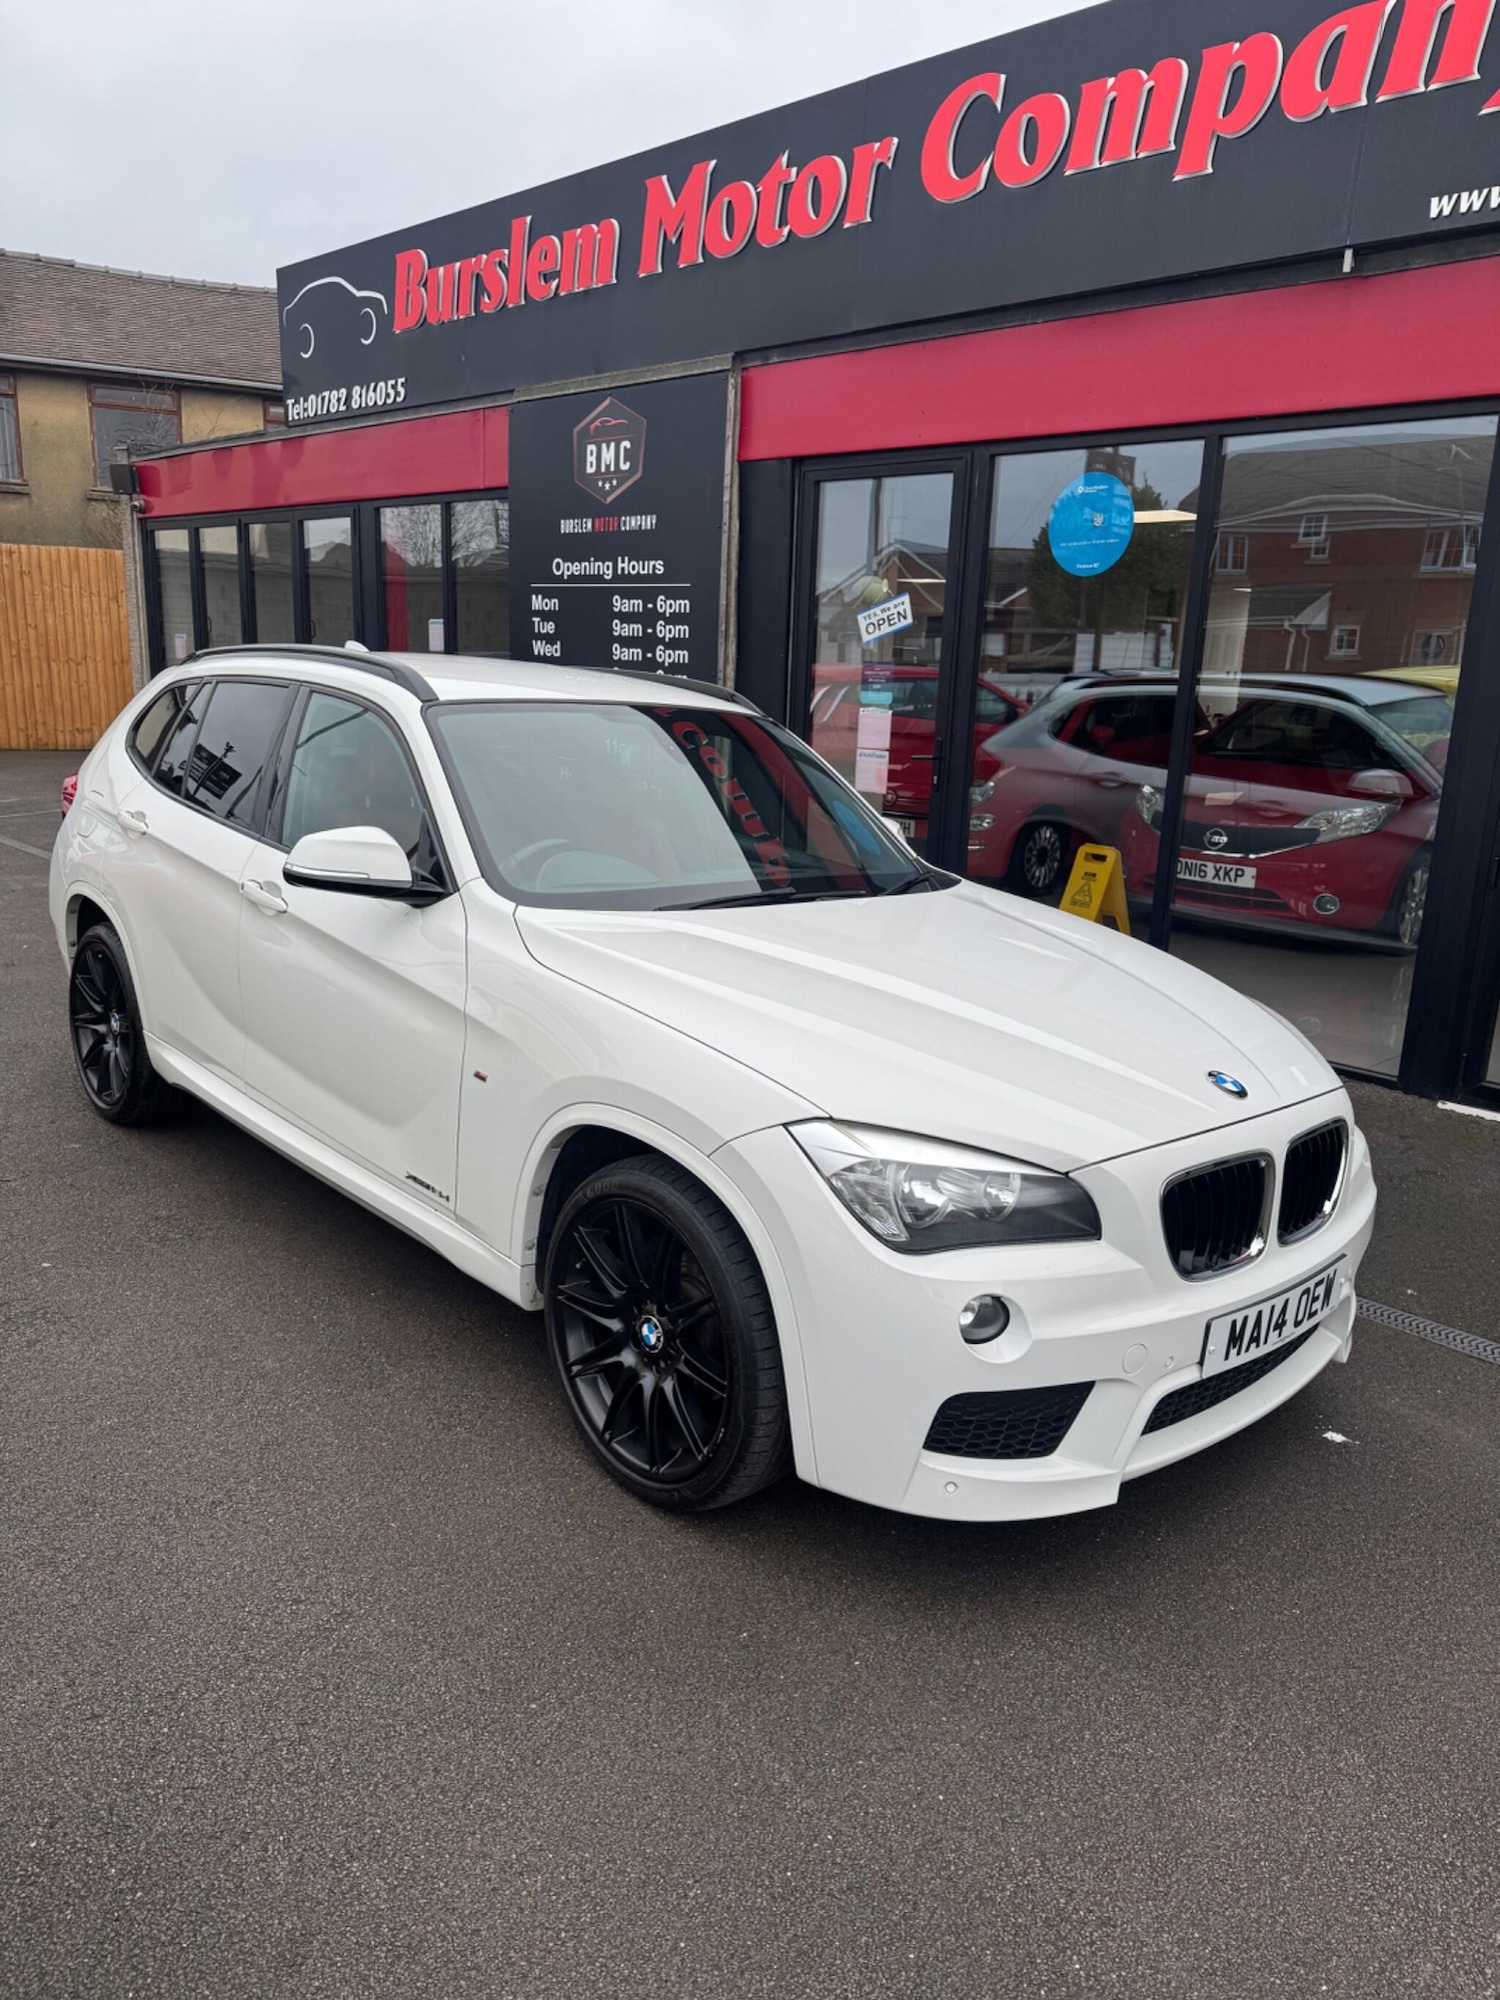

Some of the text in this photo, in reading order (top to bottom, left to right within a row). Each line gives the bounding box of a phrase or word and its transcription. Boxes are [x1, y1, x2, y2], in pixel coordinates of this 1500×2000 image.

[393, 0, 1500, 334] Burslem Motor Compan
[286, 377, 406, 421] Tel:01782 816055
[586, 440, 631, 474] BMC
[560, 514, 657, 533] BURSLEM MOTOR COMPANY
[552, 556, 665, 580] Opening Hours
[531, 594, 559, 611] Mon
[612, 595, 643, 612] 9am
[656, 595, 690, 617] 6pm
[880, 606, 891, 614] We
[532, 617, 556, 634] Tue
[612, 619, 643, 636] 9am
[656, 620, 689, 642] 6pm
[865, 608, 907, 635] OPEN
[532, 640, 561, 657] Wed
[612, 643, 642, 661] 9am
[655, 645, 689, 667] 6pm
[1212, 864, 1245, 883] XKP
[1224, 1268, 1337, 1361] MA14 OEW
